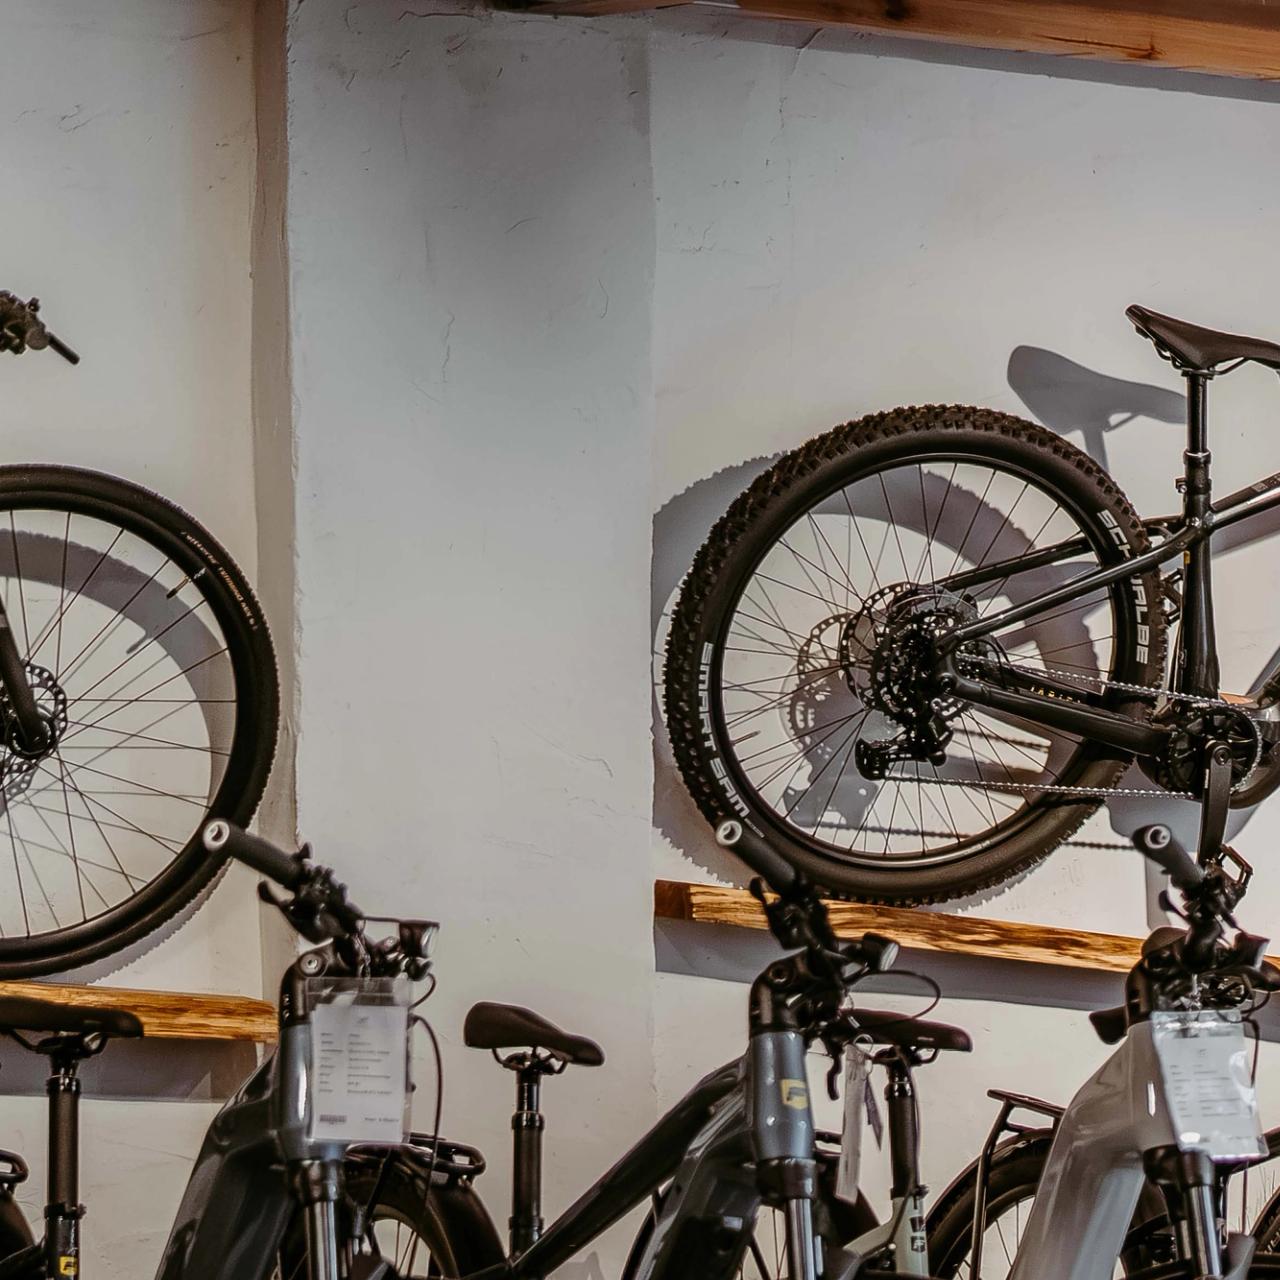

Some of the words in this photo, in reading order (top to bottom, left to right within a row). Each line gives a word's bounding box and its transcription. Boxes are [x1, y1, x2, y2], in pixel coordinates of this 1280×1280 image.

[1097, 509, 1151, 665] SCHALBE
[699, 641, 717, 751] SMART
[710, 757, 750, 818] SAM
